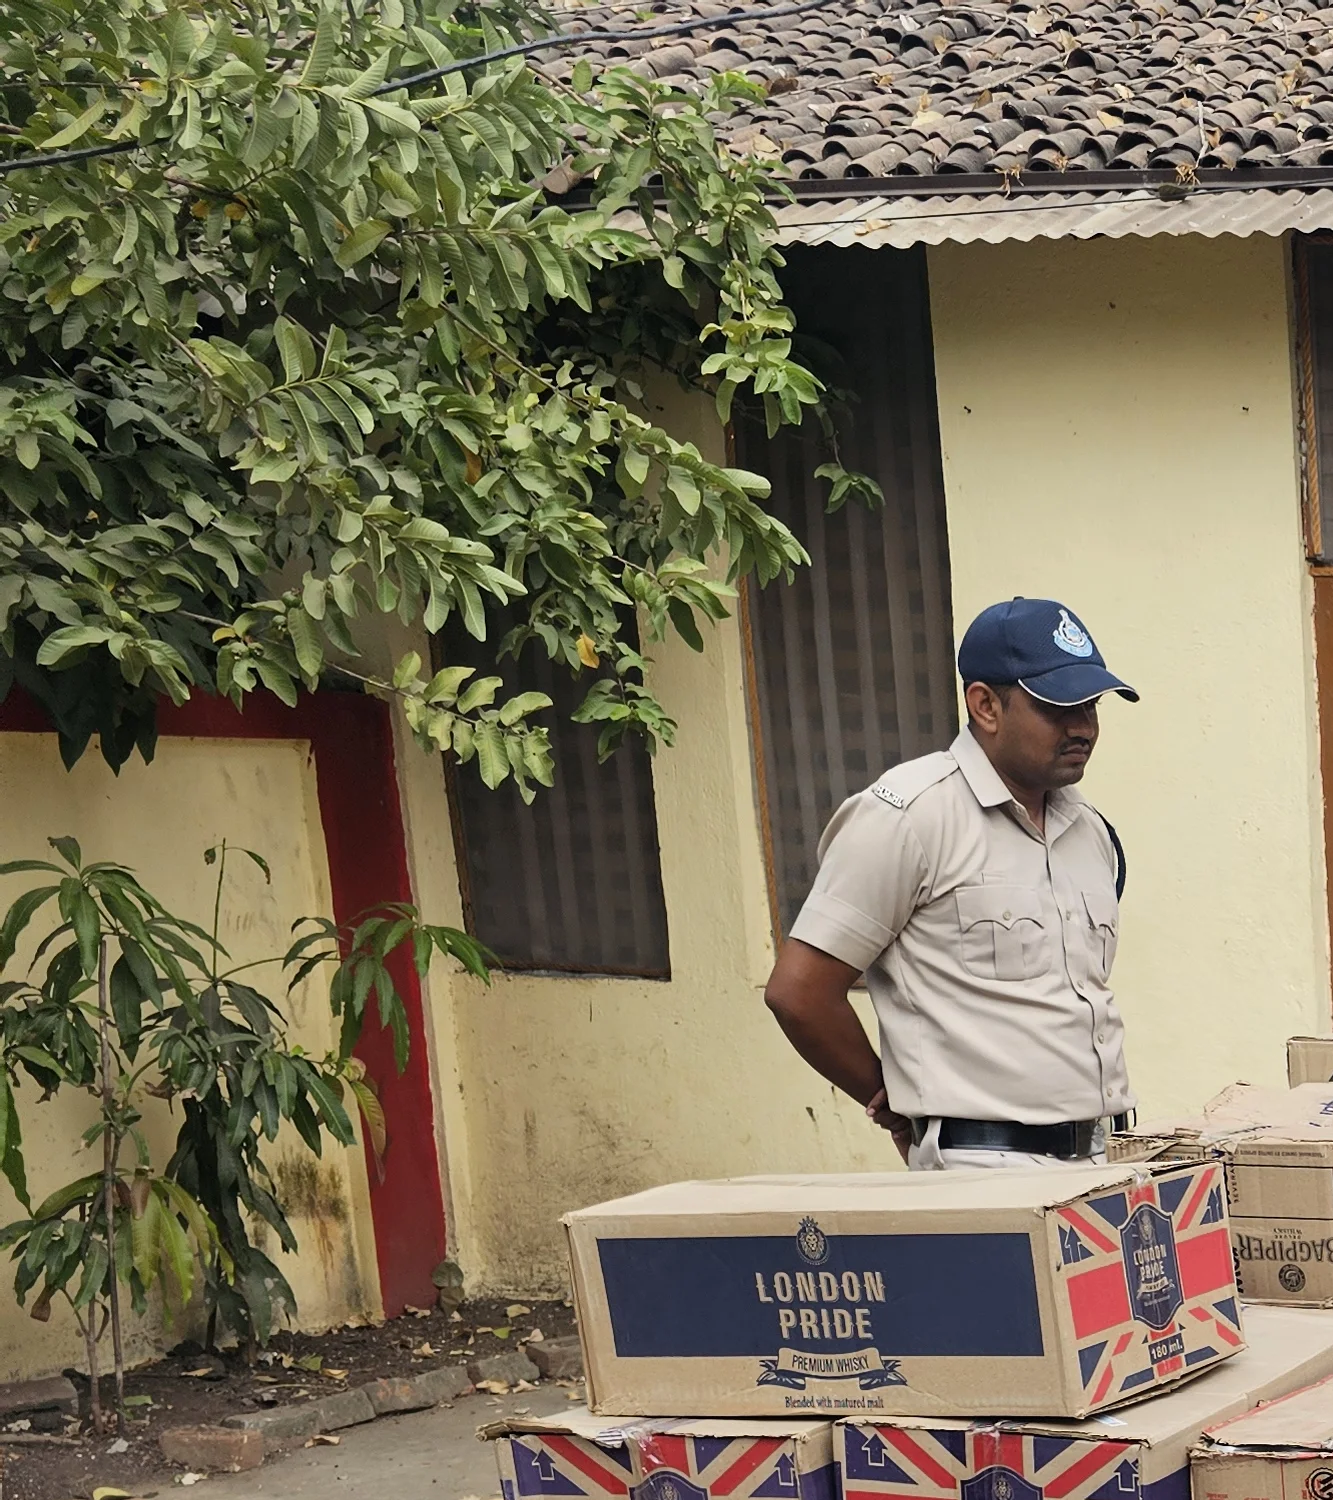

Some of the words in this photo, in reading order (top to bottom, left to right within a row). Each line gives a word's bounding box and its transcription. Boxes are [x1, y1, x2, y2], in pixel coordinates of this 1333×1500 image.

[1133, 1244, 1167, 1266] LONDON
[1139, 1261, 1164, 1281] PRIDE
[755, 1271, 886, 1303] LONDON
[778, 1308, 874, 1340] PRIDE
[1151, 1345, 1167, 1360] 180
[1169, 1339, 1183, 1353] ml.
[792, 1355, 833, 1373] PREMIUM
[835, 1355, 869, 1371] WHISKY
[785, 1396, 815, 1408] Blended
[816, 1396, 832, 1408] with
[834, 1396, 865, 1408] matured
[867, 1396, 884, 1408] malt
